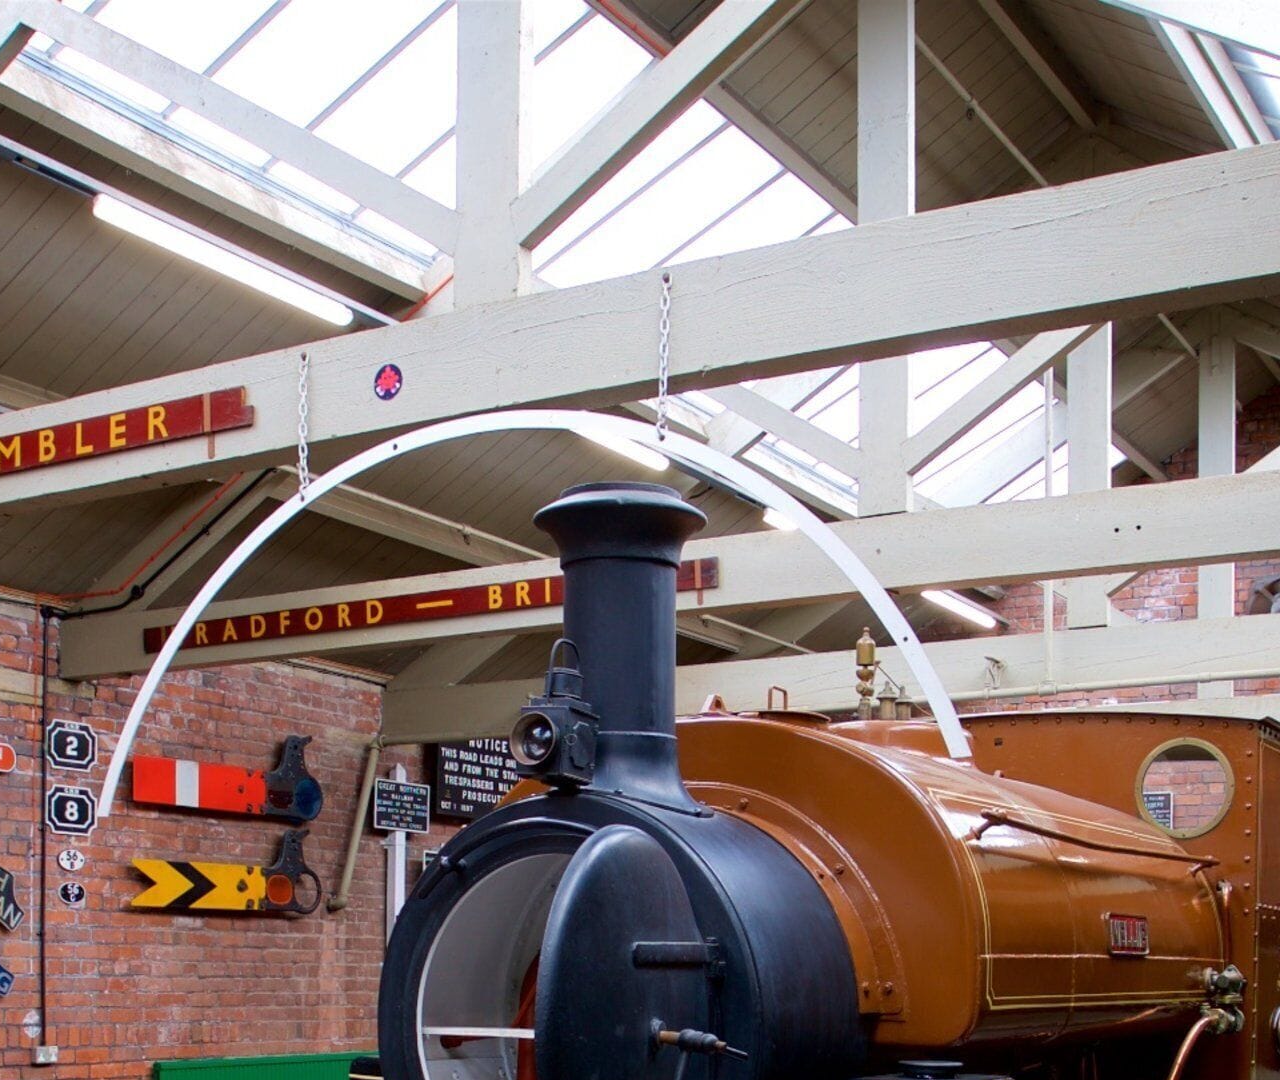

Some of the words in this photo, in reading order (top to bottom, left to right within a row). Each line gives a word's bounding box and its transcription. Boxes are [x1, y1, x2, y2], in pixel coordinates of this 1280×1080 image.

[65, 736, 79, 756] 2
[469, 739, 509, 753] NOTICE
[441, 747, 457, 759] THIS
[460, 750, 478, 763] ROAD
[480, 754, 503, 767] LEADS
[444, 761, 459, 772] AND
[462, 763, 482, 776] FROM
[485, 768, 499, 778] THE
[444, 774, 494, 791] TRESPASSERS
[462, 790, 503, 804] PROSECUT
[65, 801, 80, 822] 8
[66, 850, 78, 862] 56
[67, 884, 79, 895] 56
